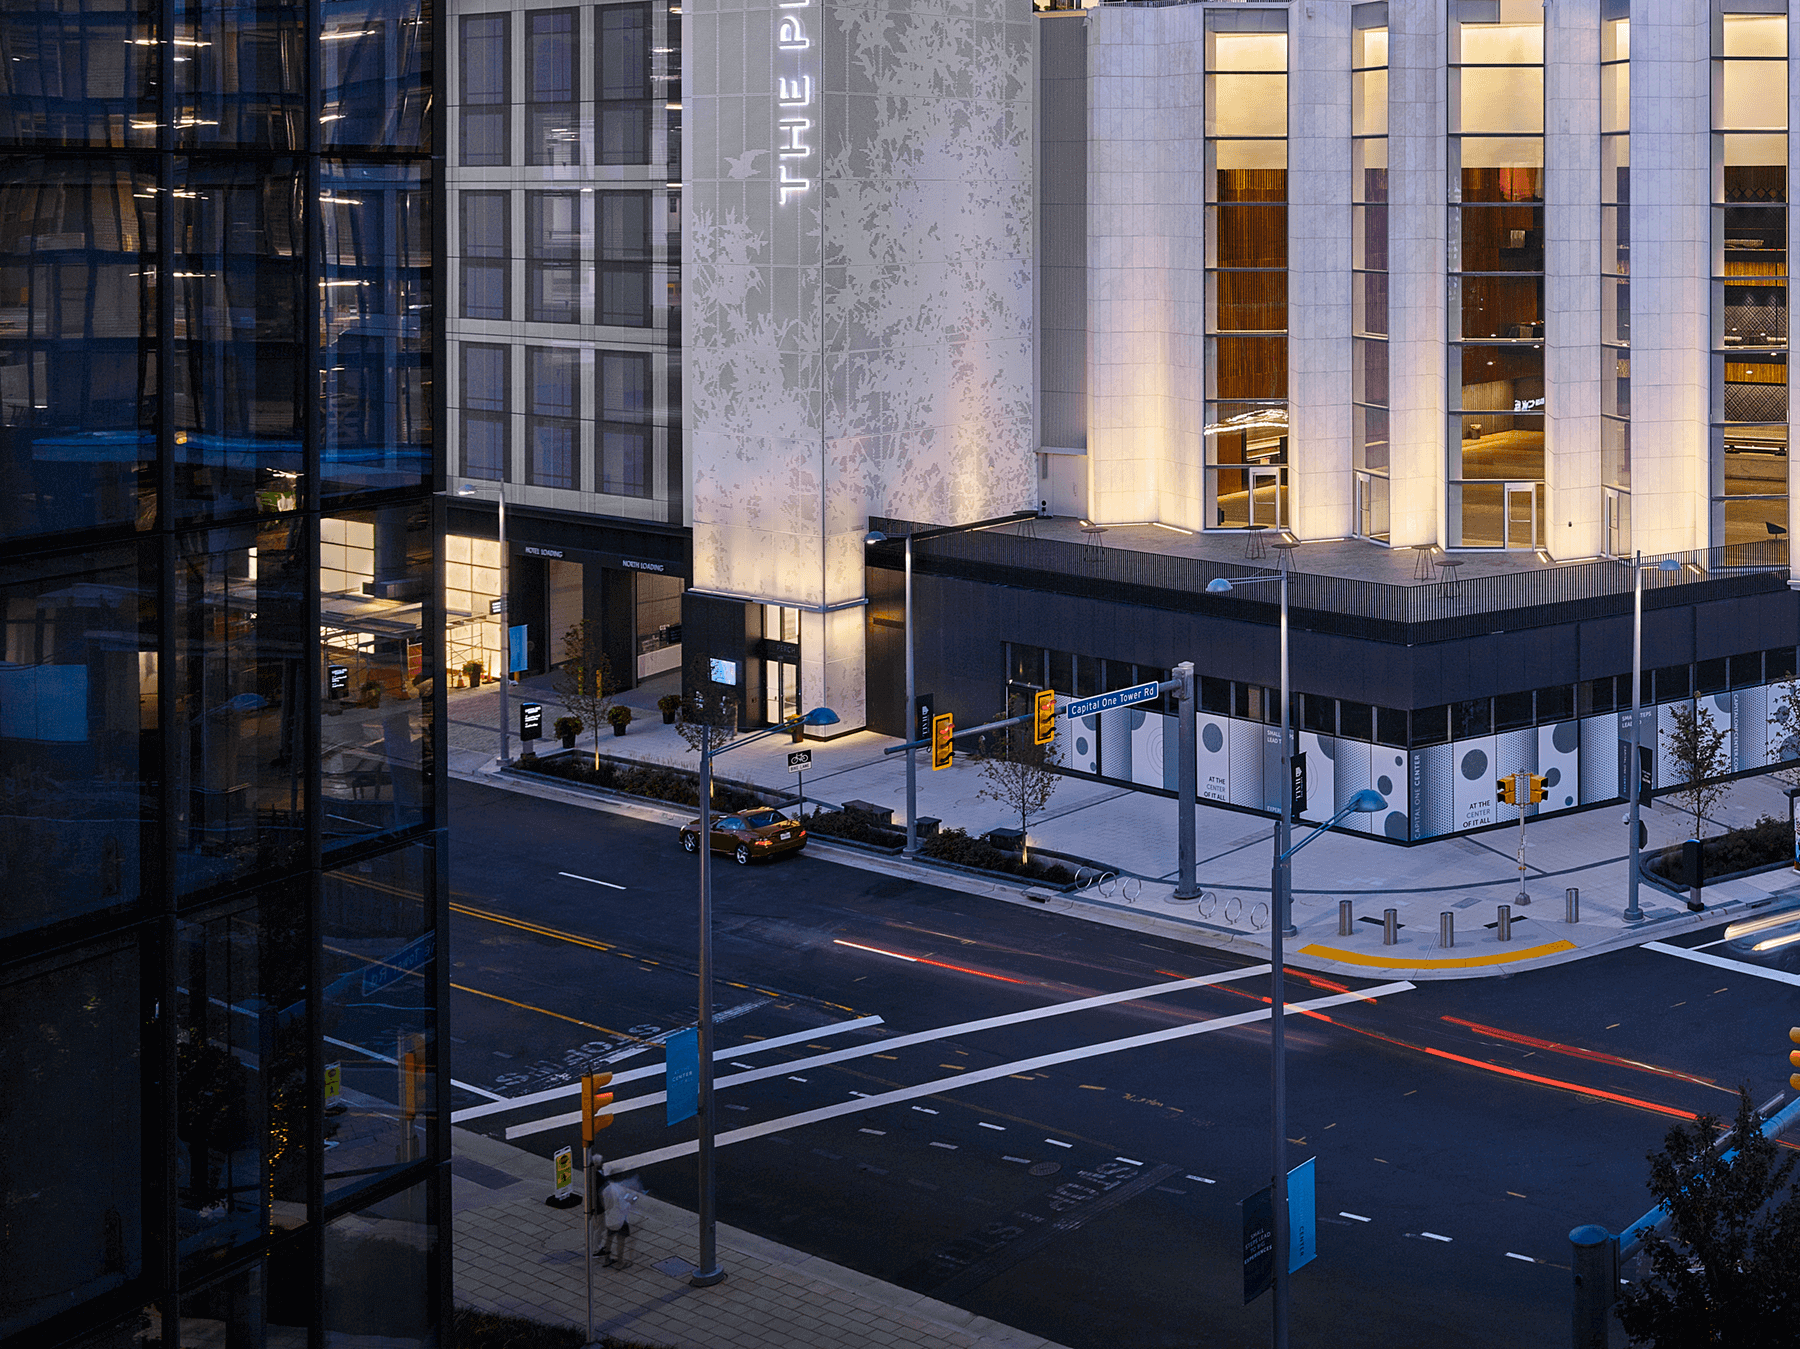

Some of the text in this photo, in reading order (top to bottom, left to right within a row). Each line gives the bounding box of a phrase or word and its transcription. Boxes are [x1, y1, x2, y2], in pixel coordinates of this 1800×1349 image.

[779, 74, 810, 206] THE
[525, 546, 564, 558] HOTEL LOADING
[622, 560, 664, 572] NORTH LOADING
[1072, 687, 1154, 715] Capital One Tower Rd
[1216, 777, 1225, 785] THE
[1206, 784, 1225, 792] CENTER
[1466, 809, 1490, 818] CENTER
[1259, 1231, 1272, 1243] LEAD
[1244, 1244, 1273, 1265] EXPERIENCES
